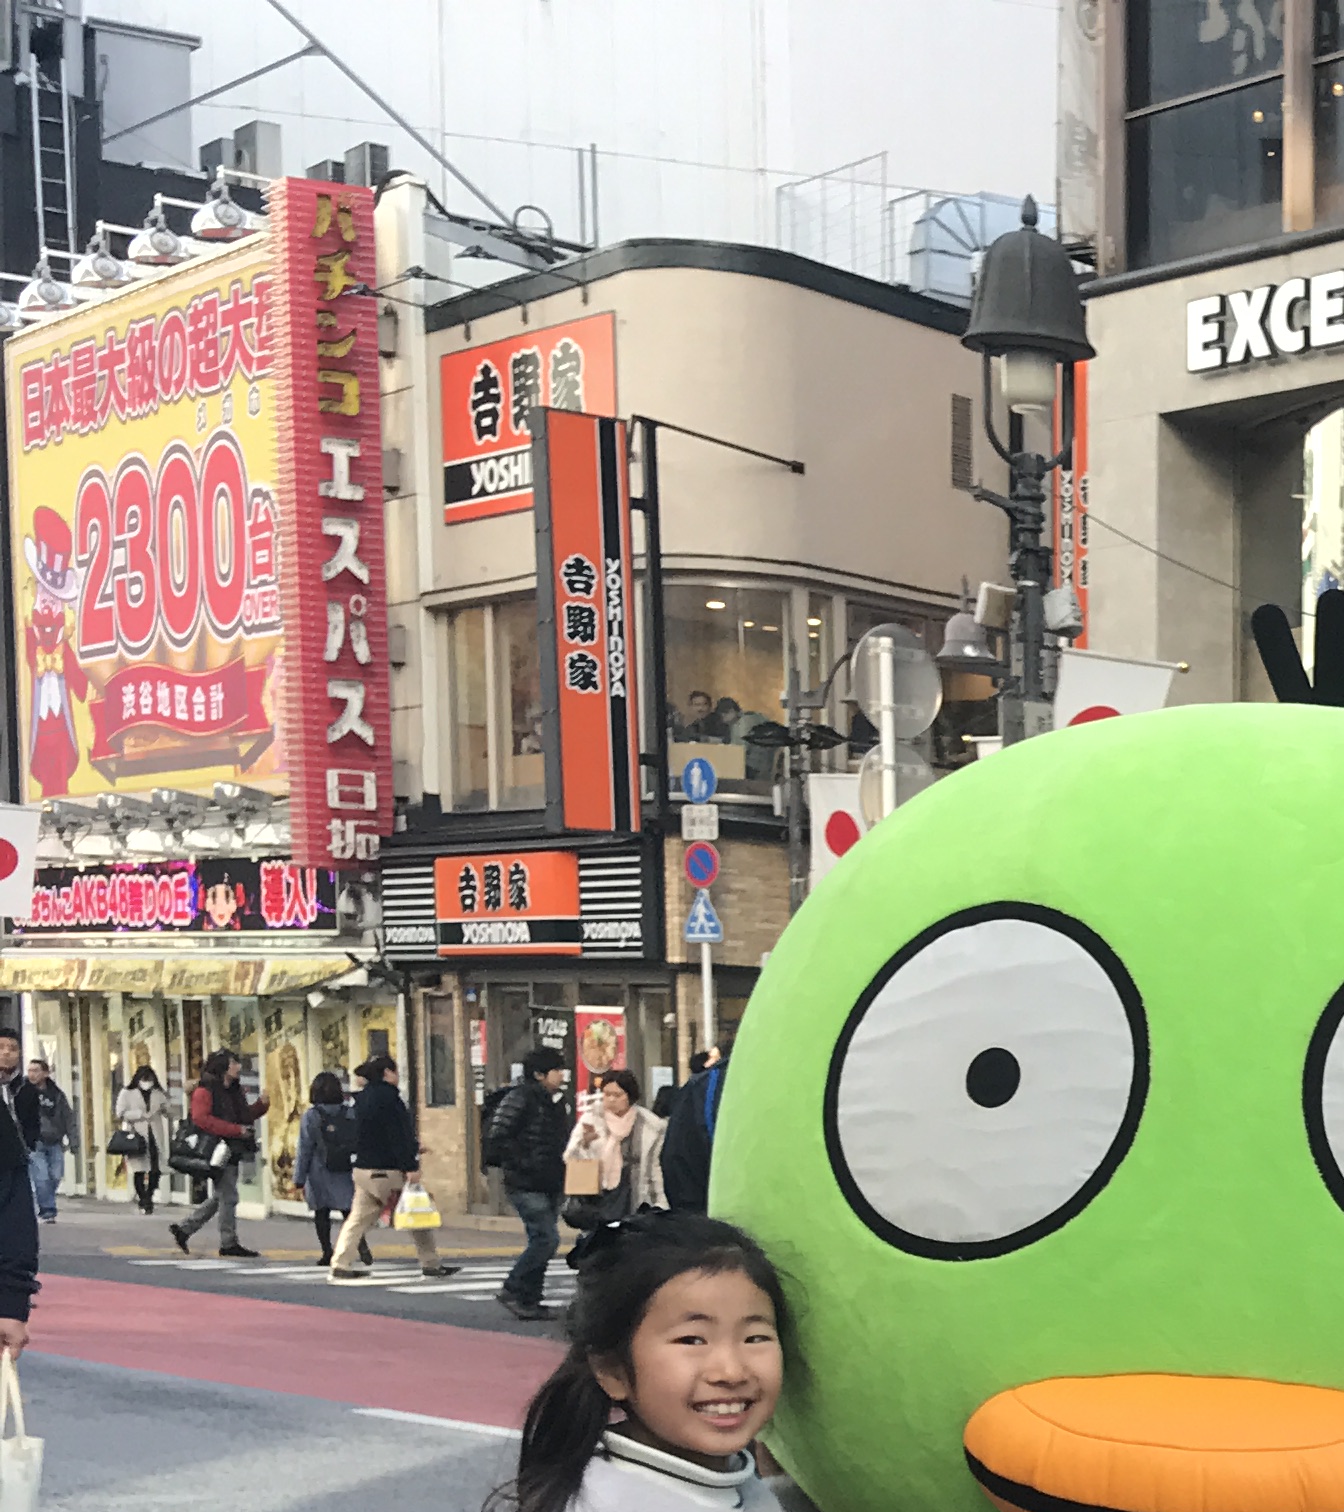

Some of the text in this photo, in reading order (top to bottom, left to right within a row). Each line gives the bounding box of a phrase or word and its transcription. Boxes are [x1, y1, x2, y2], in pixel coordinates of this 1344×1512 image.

[470, 337, 586, 445] 吉野家
[559, 553, 602, 694] 吉野家
[121, 680, 224, 721] 渋谷地区合計
[458, 859, 532, 914] 吉野家
